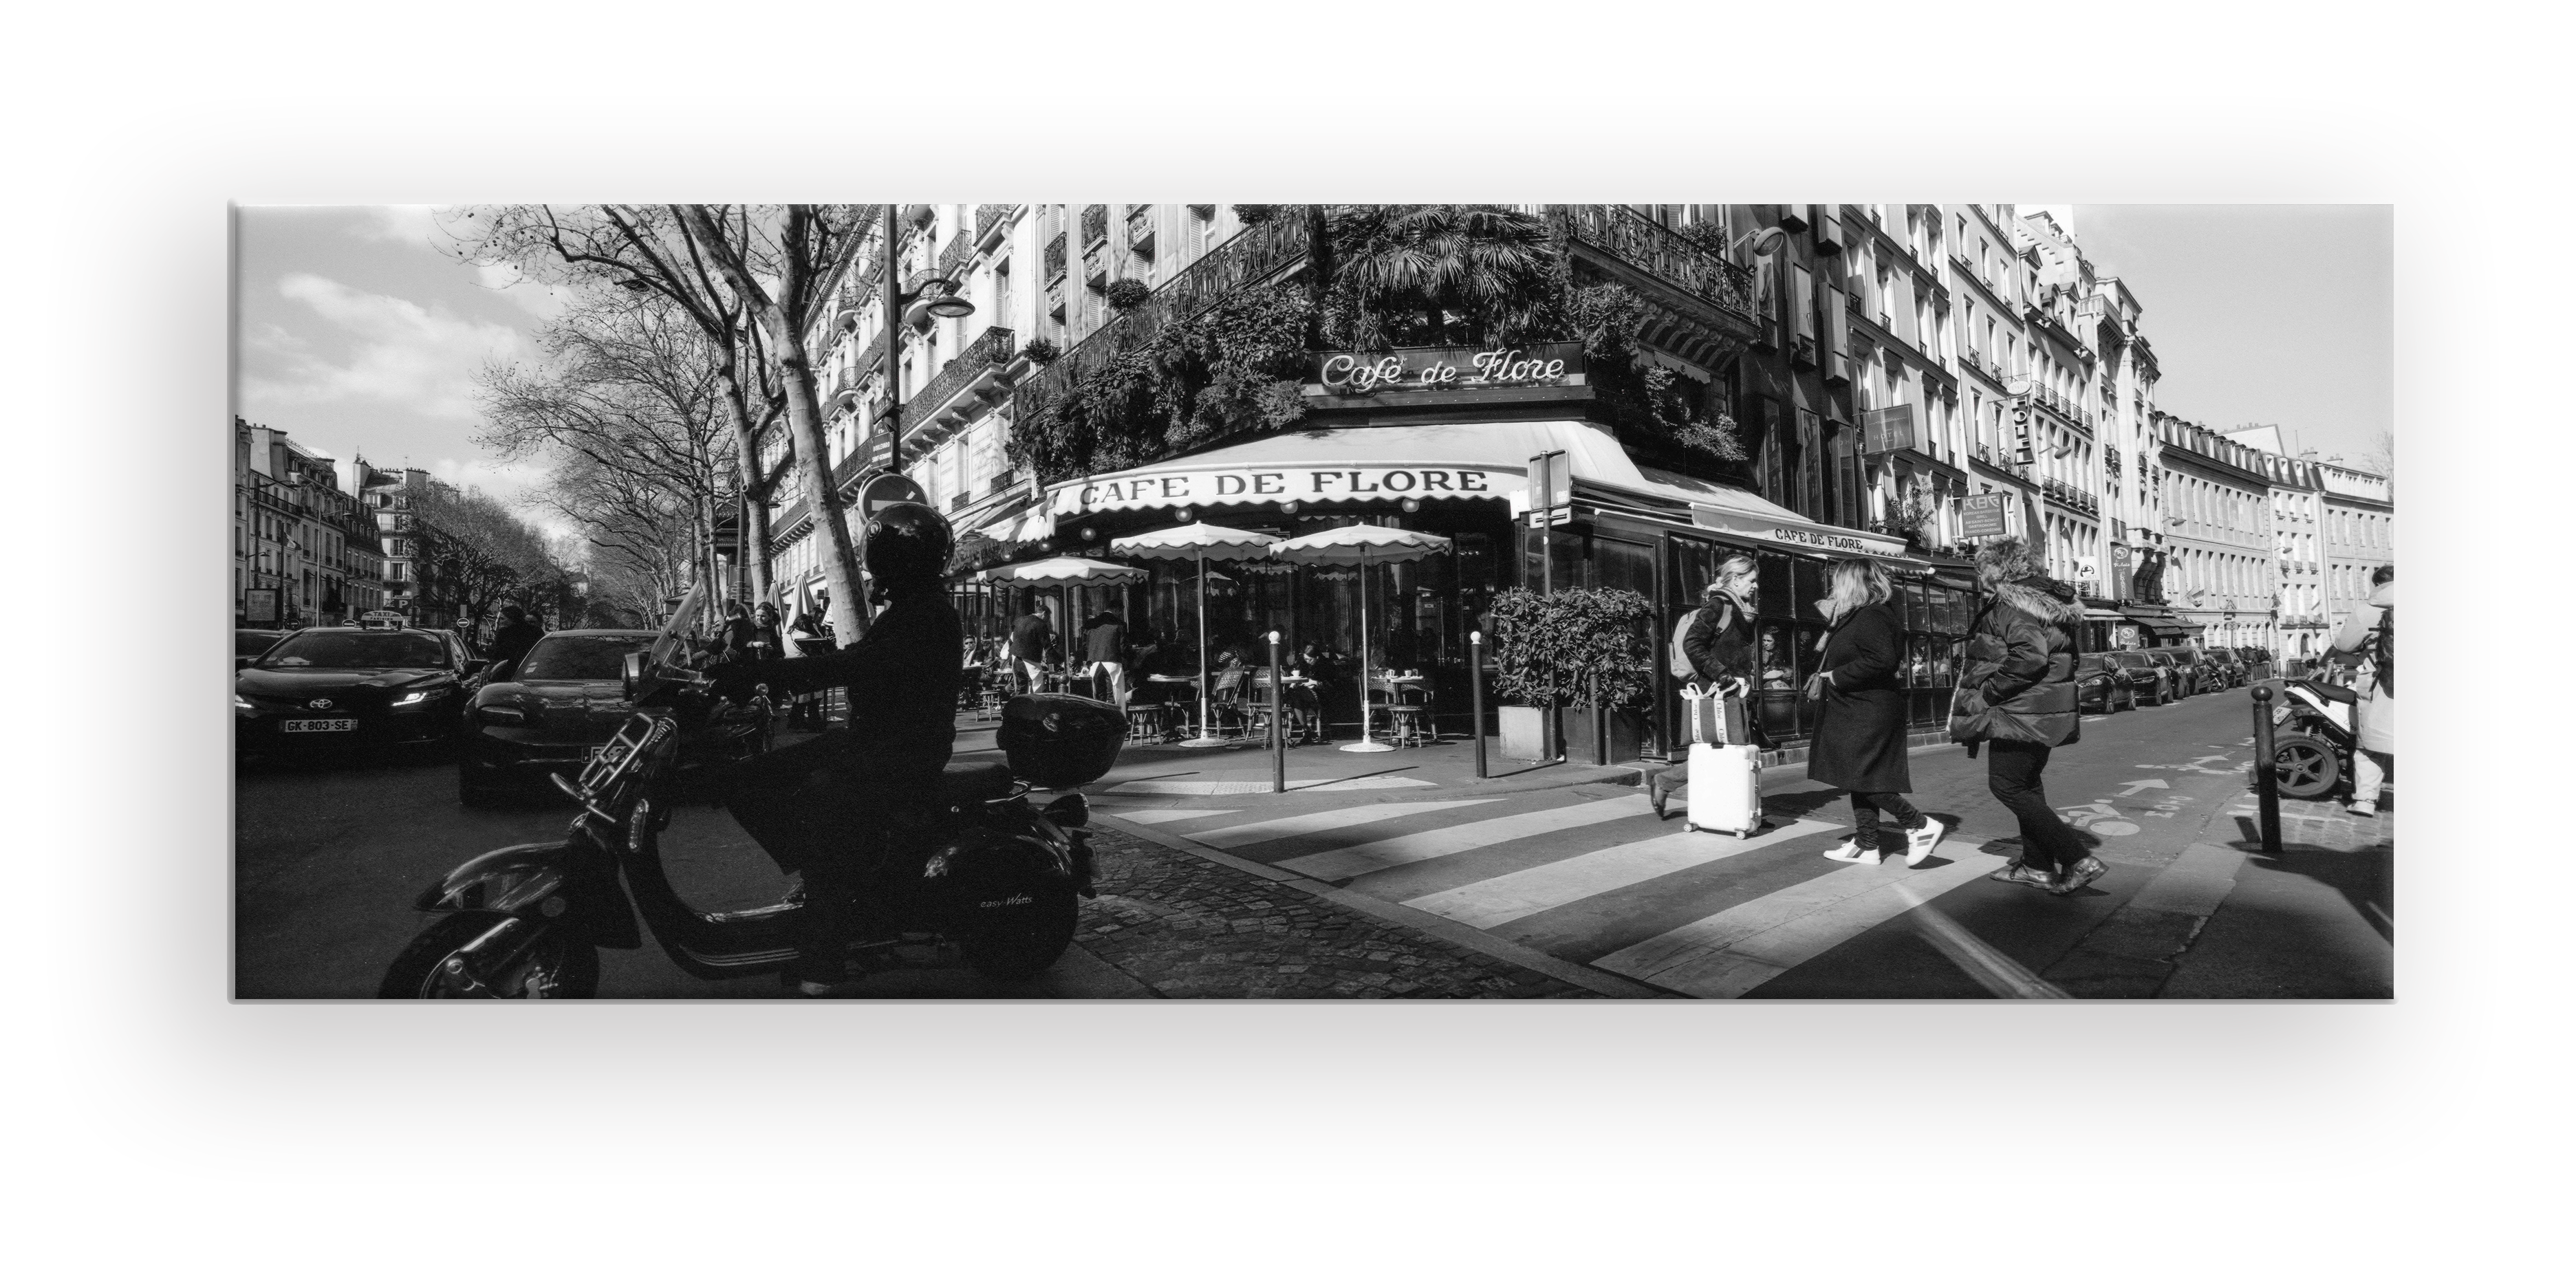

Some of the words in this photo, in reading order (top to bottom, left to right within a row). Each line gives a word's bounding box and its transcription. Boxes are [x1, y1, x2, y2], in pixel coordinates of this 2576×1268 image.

[1321, 354, 1407, 393] Café
[1421, 361, 1456, 384] de
[1471, 347, 1565, 382] Flore
[1873, 430, 1904, 441] HOTEL
[2011, 396, 2033, 466] HOTEL
[1079, 476, 1190, 506] CAFE
[1215, 472, 1285, 496] DE
[1311, 470, 1488, 492] FLORE
[1775, 528, 1807, 543] CAFE
[1810, 533, 1825, 545] DE
[1828, 536, 1863, 549] FLORE
[399, 600, 409, 609] P
[288, 720, 349, 731] GK-803-SE
